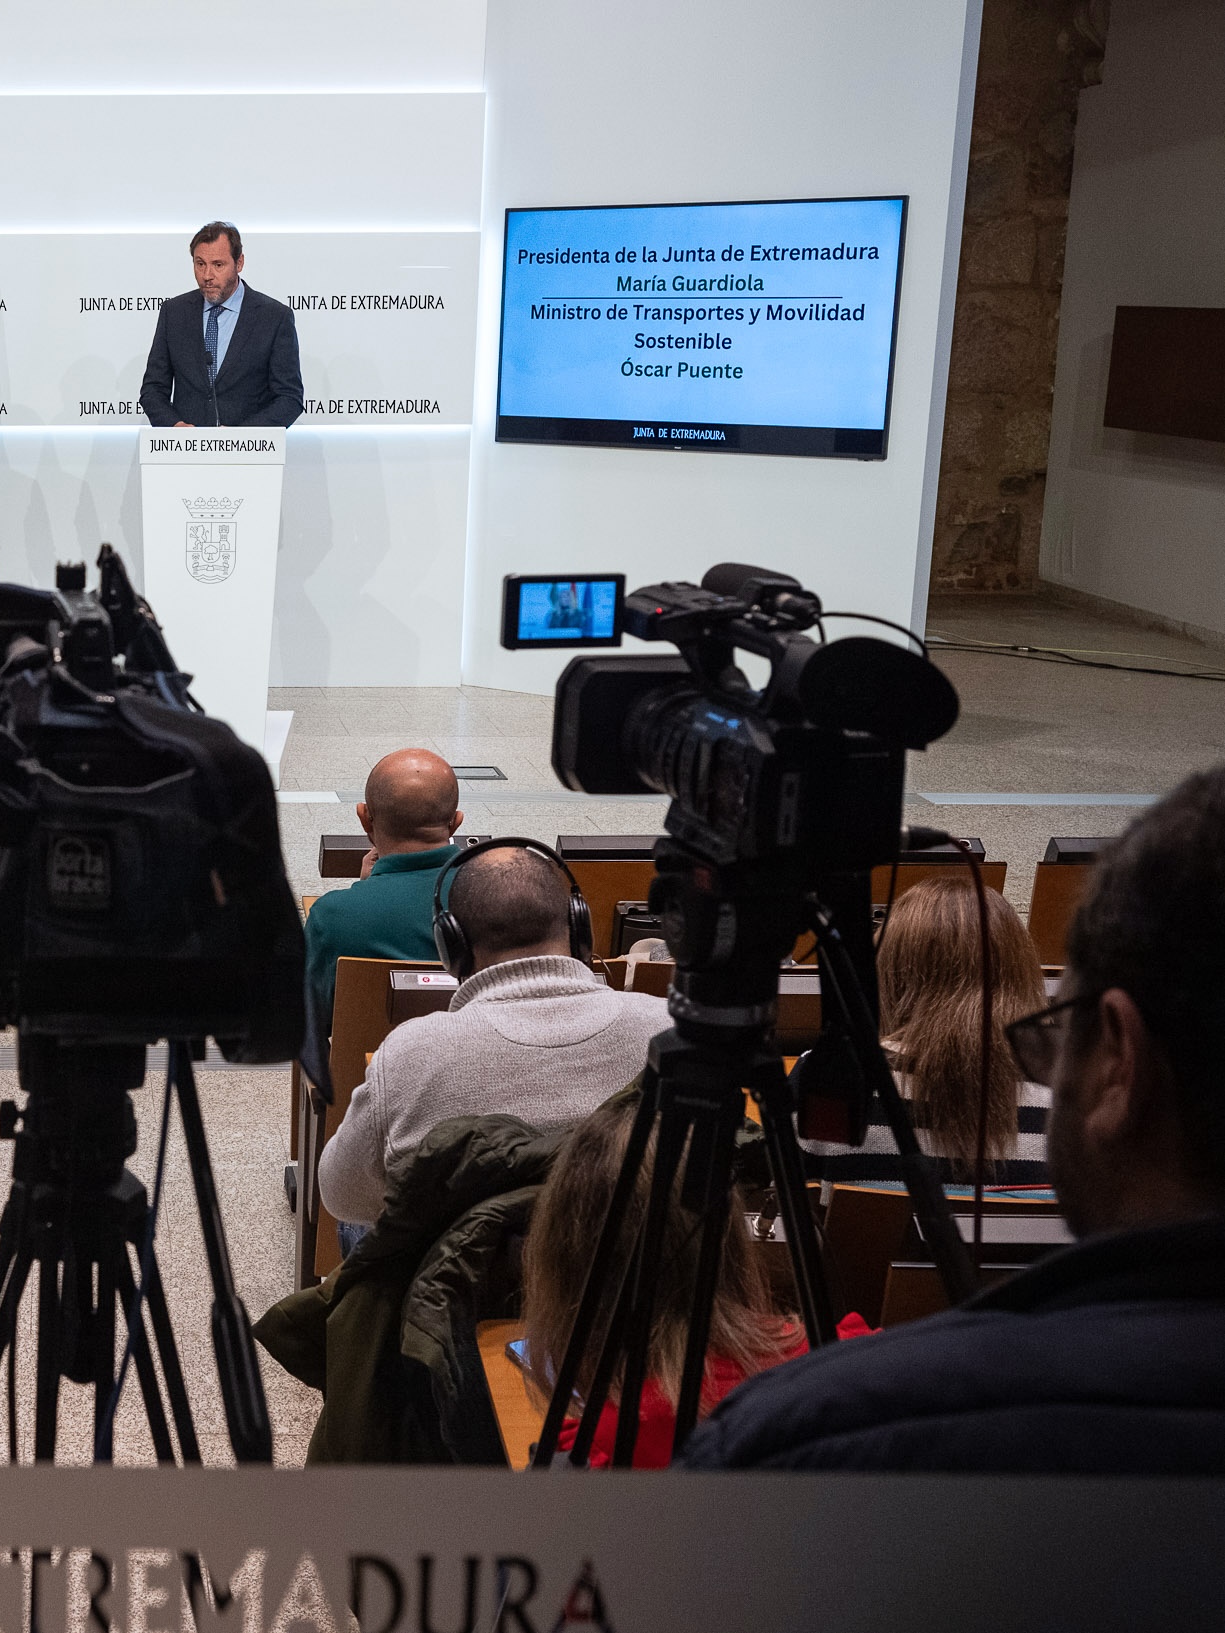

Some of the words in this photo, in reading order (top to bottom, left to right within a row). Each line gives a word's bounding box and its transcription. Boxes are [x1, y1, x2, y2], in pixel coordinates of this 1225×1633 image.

[518, 248, 610, 265] Presidenta
[615, 247, 636, 263] de
[643, 246, 658, 263] la
[662, 247, 715, 263] Junta
[721, 245, 744, 262] de
[750, 243, 879, 262] Extremadura
[617, 275, 666, 292] María
[672, 274, 764, 292] Guardiola
[80, 298, 116, 313] JUNTA
[120, 298, 133, 311] DE
[331, 296, 347, 309] DE
[351, 295, 444, 309] EXTREMADURA
[531, 304, 601, 321] Ministro
[607, 304, 628, 321] de
[633, 304, 744, 325] Transportes
[749, 308, 760, 325] y
[766, 303, 865, 321] Movilidad
[634, 332, 732, 349] Sostenible
[621, 357, 672, 378] Óscar
[678, 362, 743, 379] Puente
[80, 402, 116, 416] JUNTA
[119, 402, 133, 414] DE
[329, 400, 343, 414] DE
[348, 400, 440, 414] EXTREMADURA
[633, 427, 655, 438] JUNTA
[658, 428, 668, 438] DE
[671, 429, 726, 440] EXTREMADURA
[150, 440, 182, 453] JUNTA
[186, 440, 198, 452] DE
[201, 440, 275, 452] EXTREMADURA
